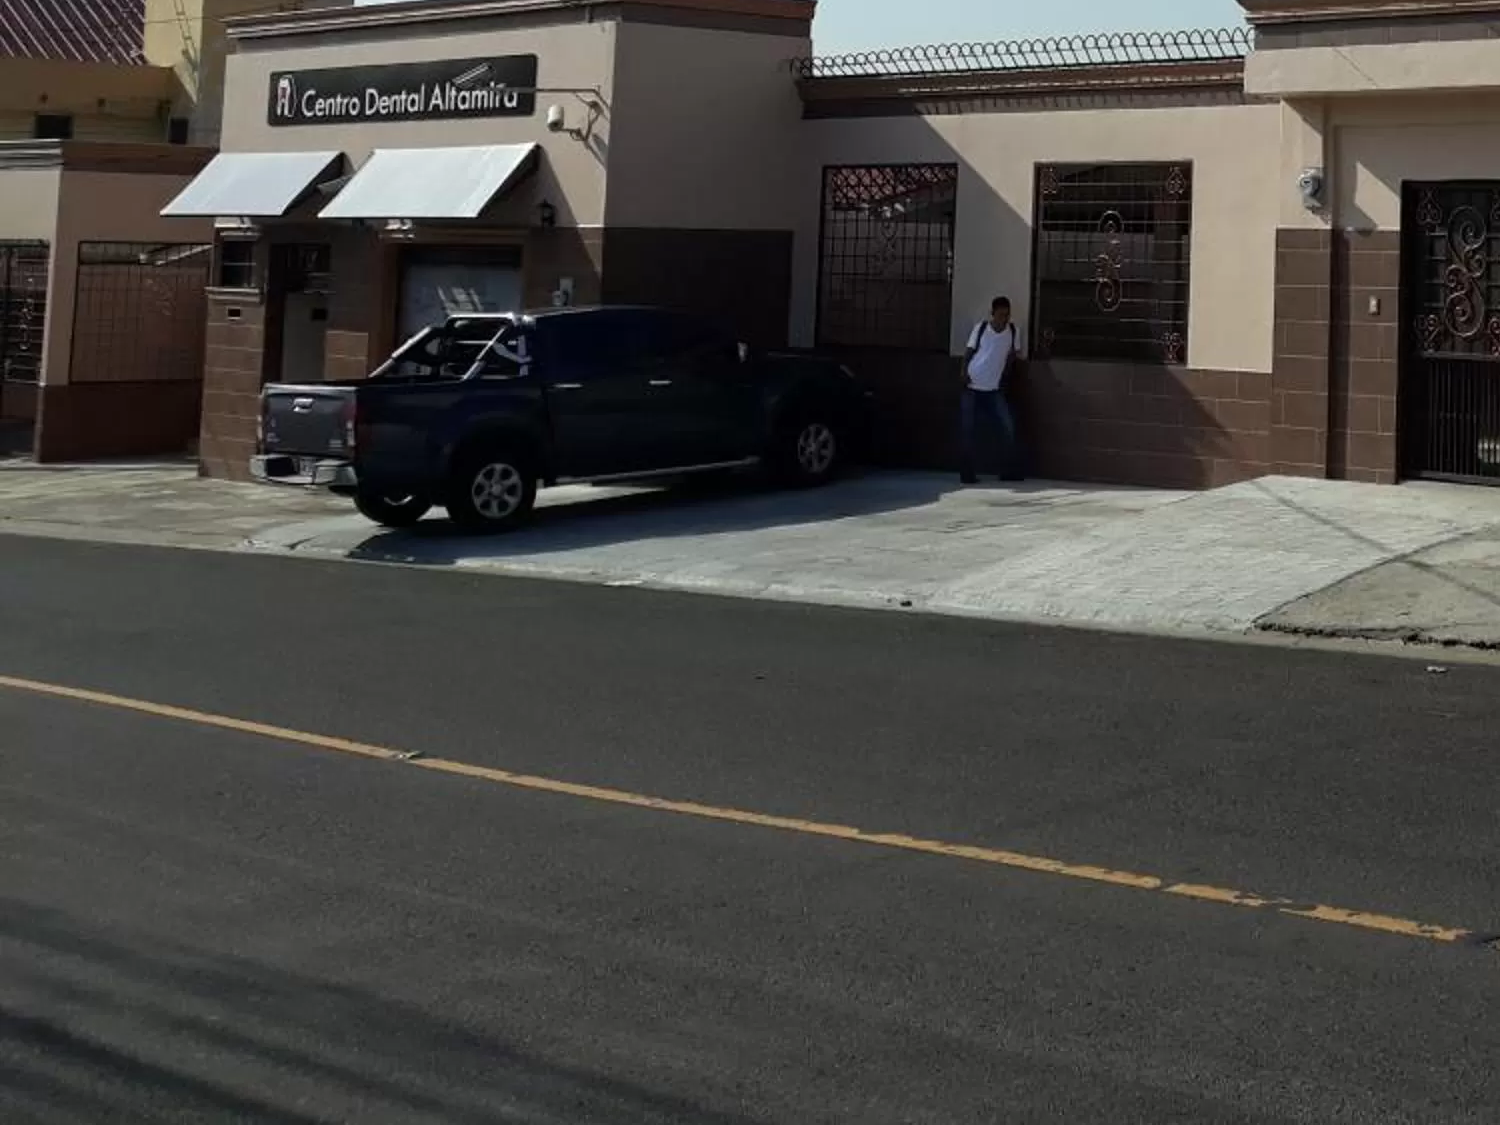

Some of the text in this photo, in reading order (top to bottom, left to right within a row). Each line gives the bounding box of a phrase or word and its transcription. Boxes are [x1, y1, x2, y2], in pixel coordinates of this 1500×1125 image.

[302, 80, 518, 117] Centro Dental Altamira
